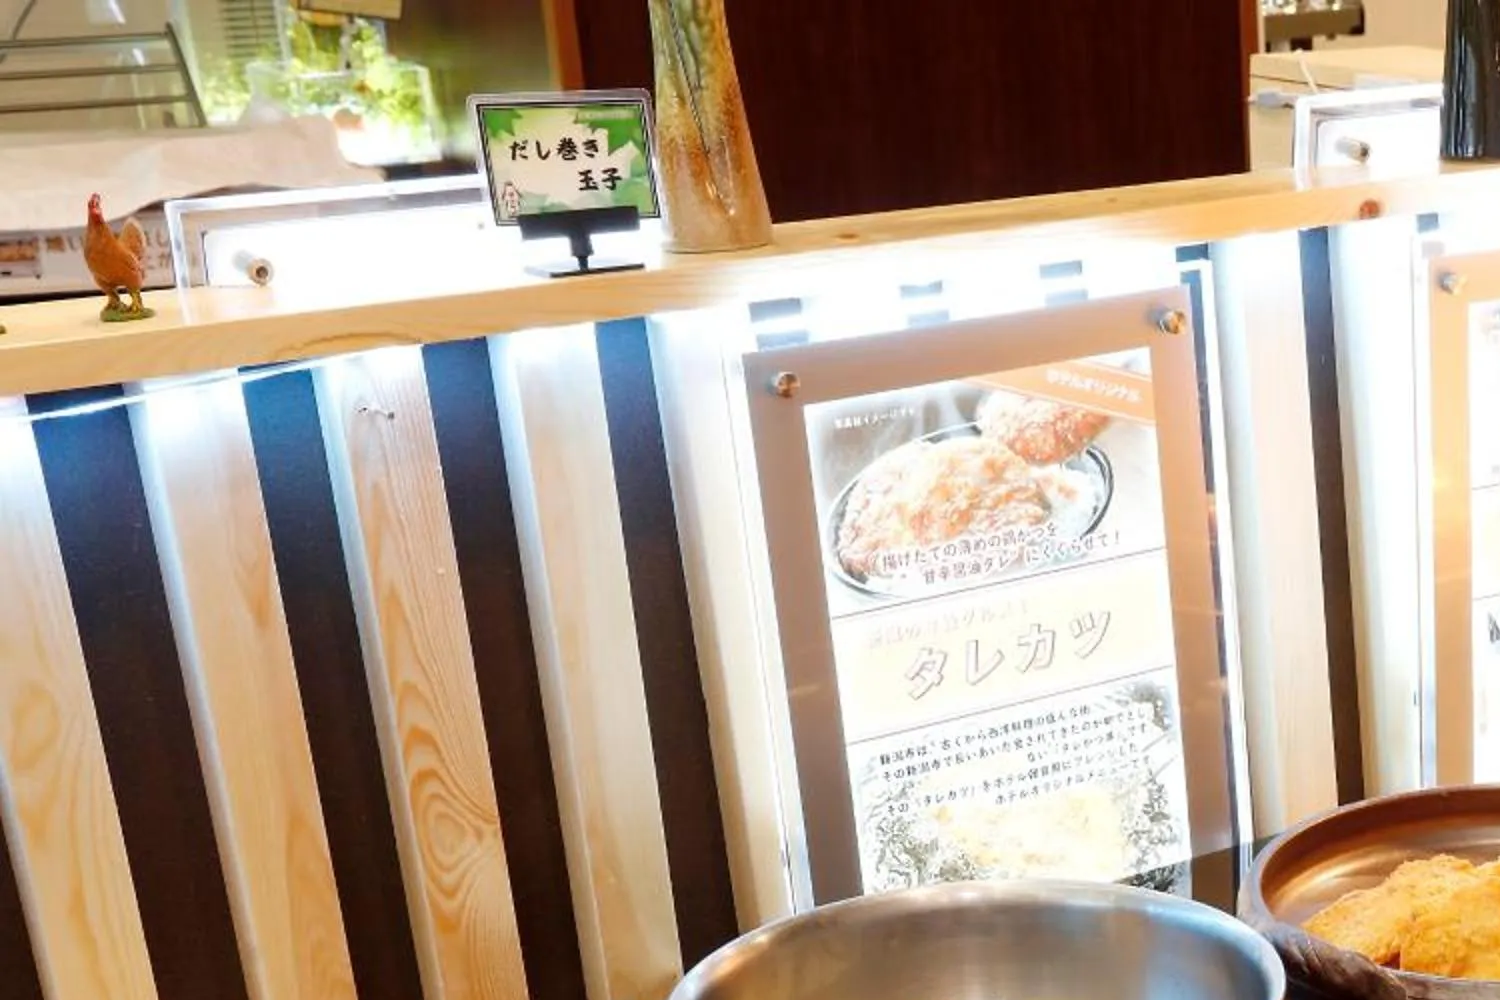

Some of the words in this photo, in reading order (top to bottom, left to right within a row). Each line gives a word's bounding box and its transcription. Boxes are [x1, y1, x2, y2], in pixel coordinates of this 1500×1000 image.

[507, 137, 600, 162] だし巻き
[577, 167, 623, 192] 玉子
[904, 607, 1113, 701] タレカツ
